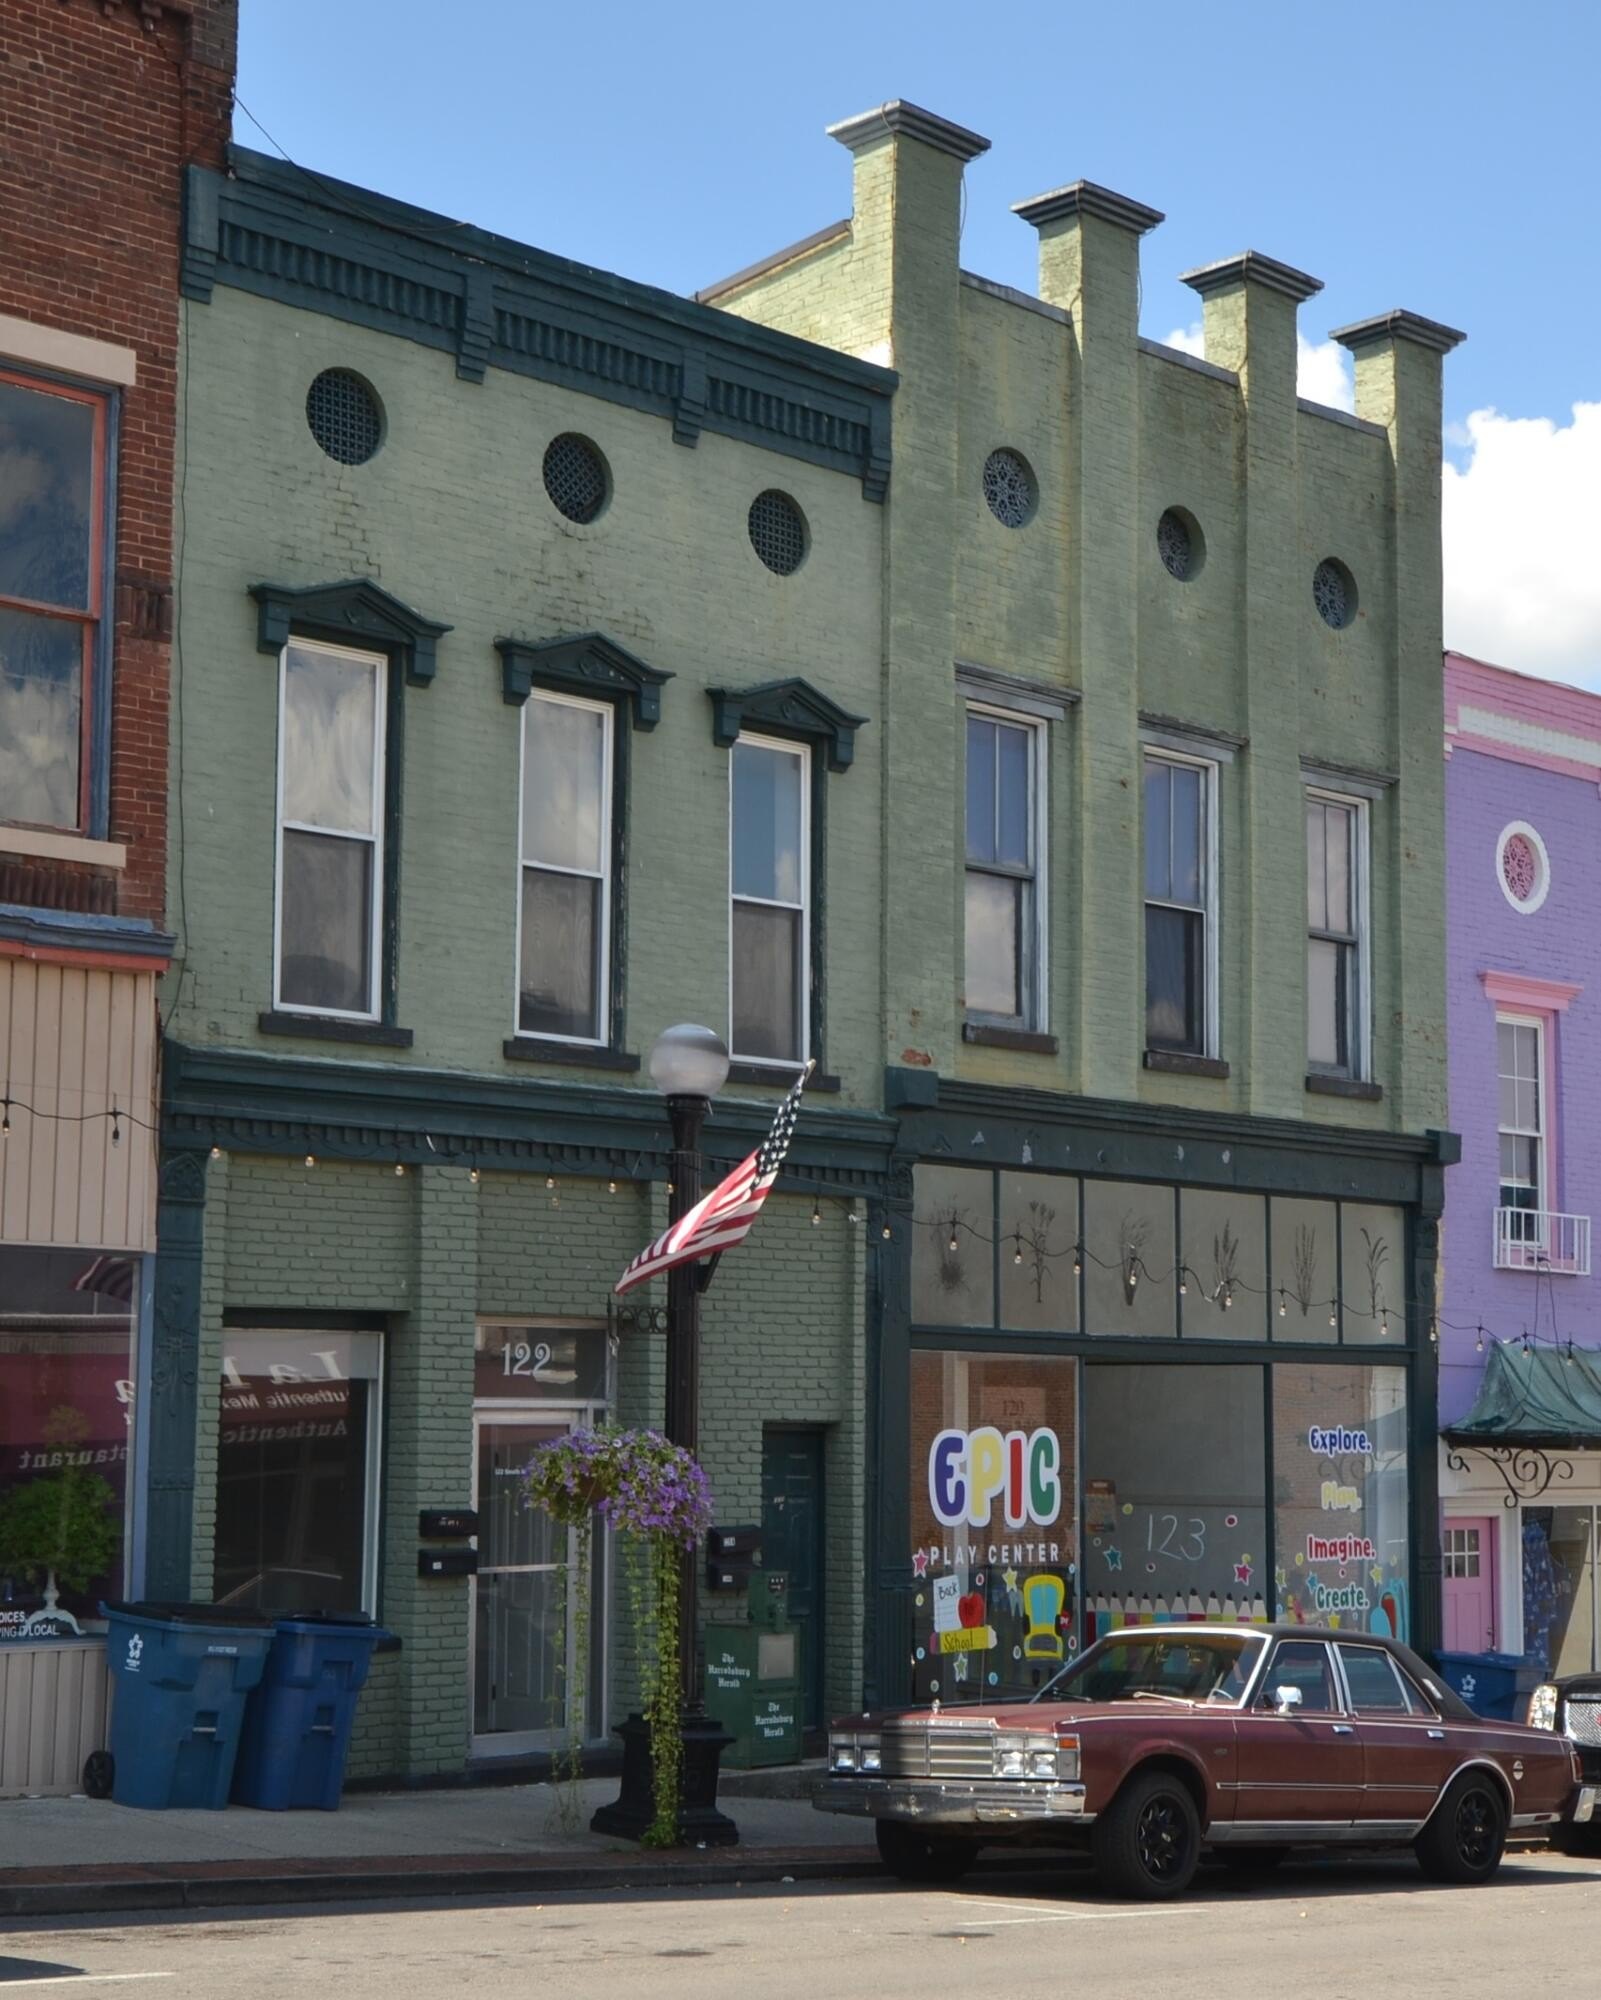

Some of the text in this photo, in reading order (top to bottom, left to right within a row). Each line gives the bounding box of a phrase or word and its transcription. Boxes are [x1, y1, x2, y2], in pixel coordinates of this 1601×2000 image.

[501, 1342, 551, 1376] 122
[1310, 1425, 1372, 1457] Explore.
[929, 1426, 1062, 1529] EPIC
[1147, 1513, 1206, 1561] 123
[1307, 1533, 1376, 1562] Imagine.
[930, 1543, 1059, 1566] PLAY CENTER
[938, 1582, 957, 1600] Back
[1315, 1583, 1369, 1611] Create.
[943, 1631, 974, 1650] School
